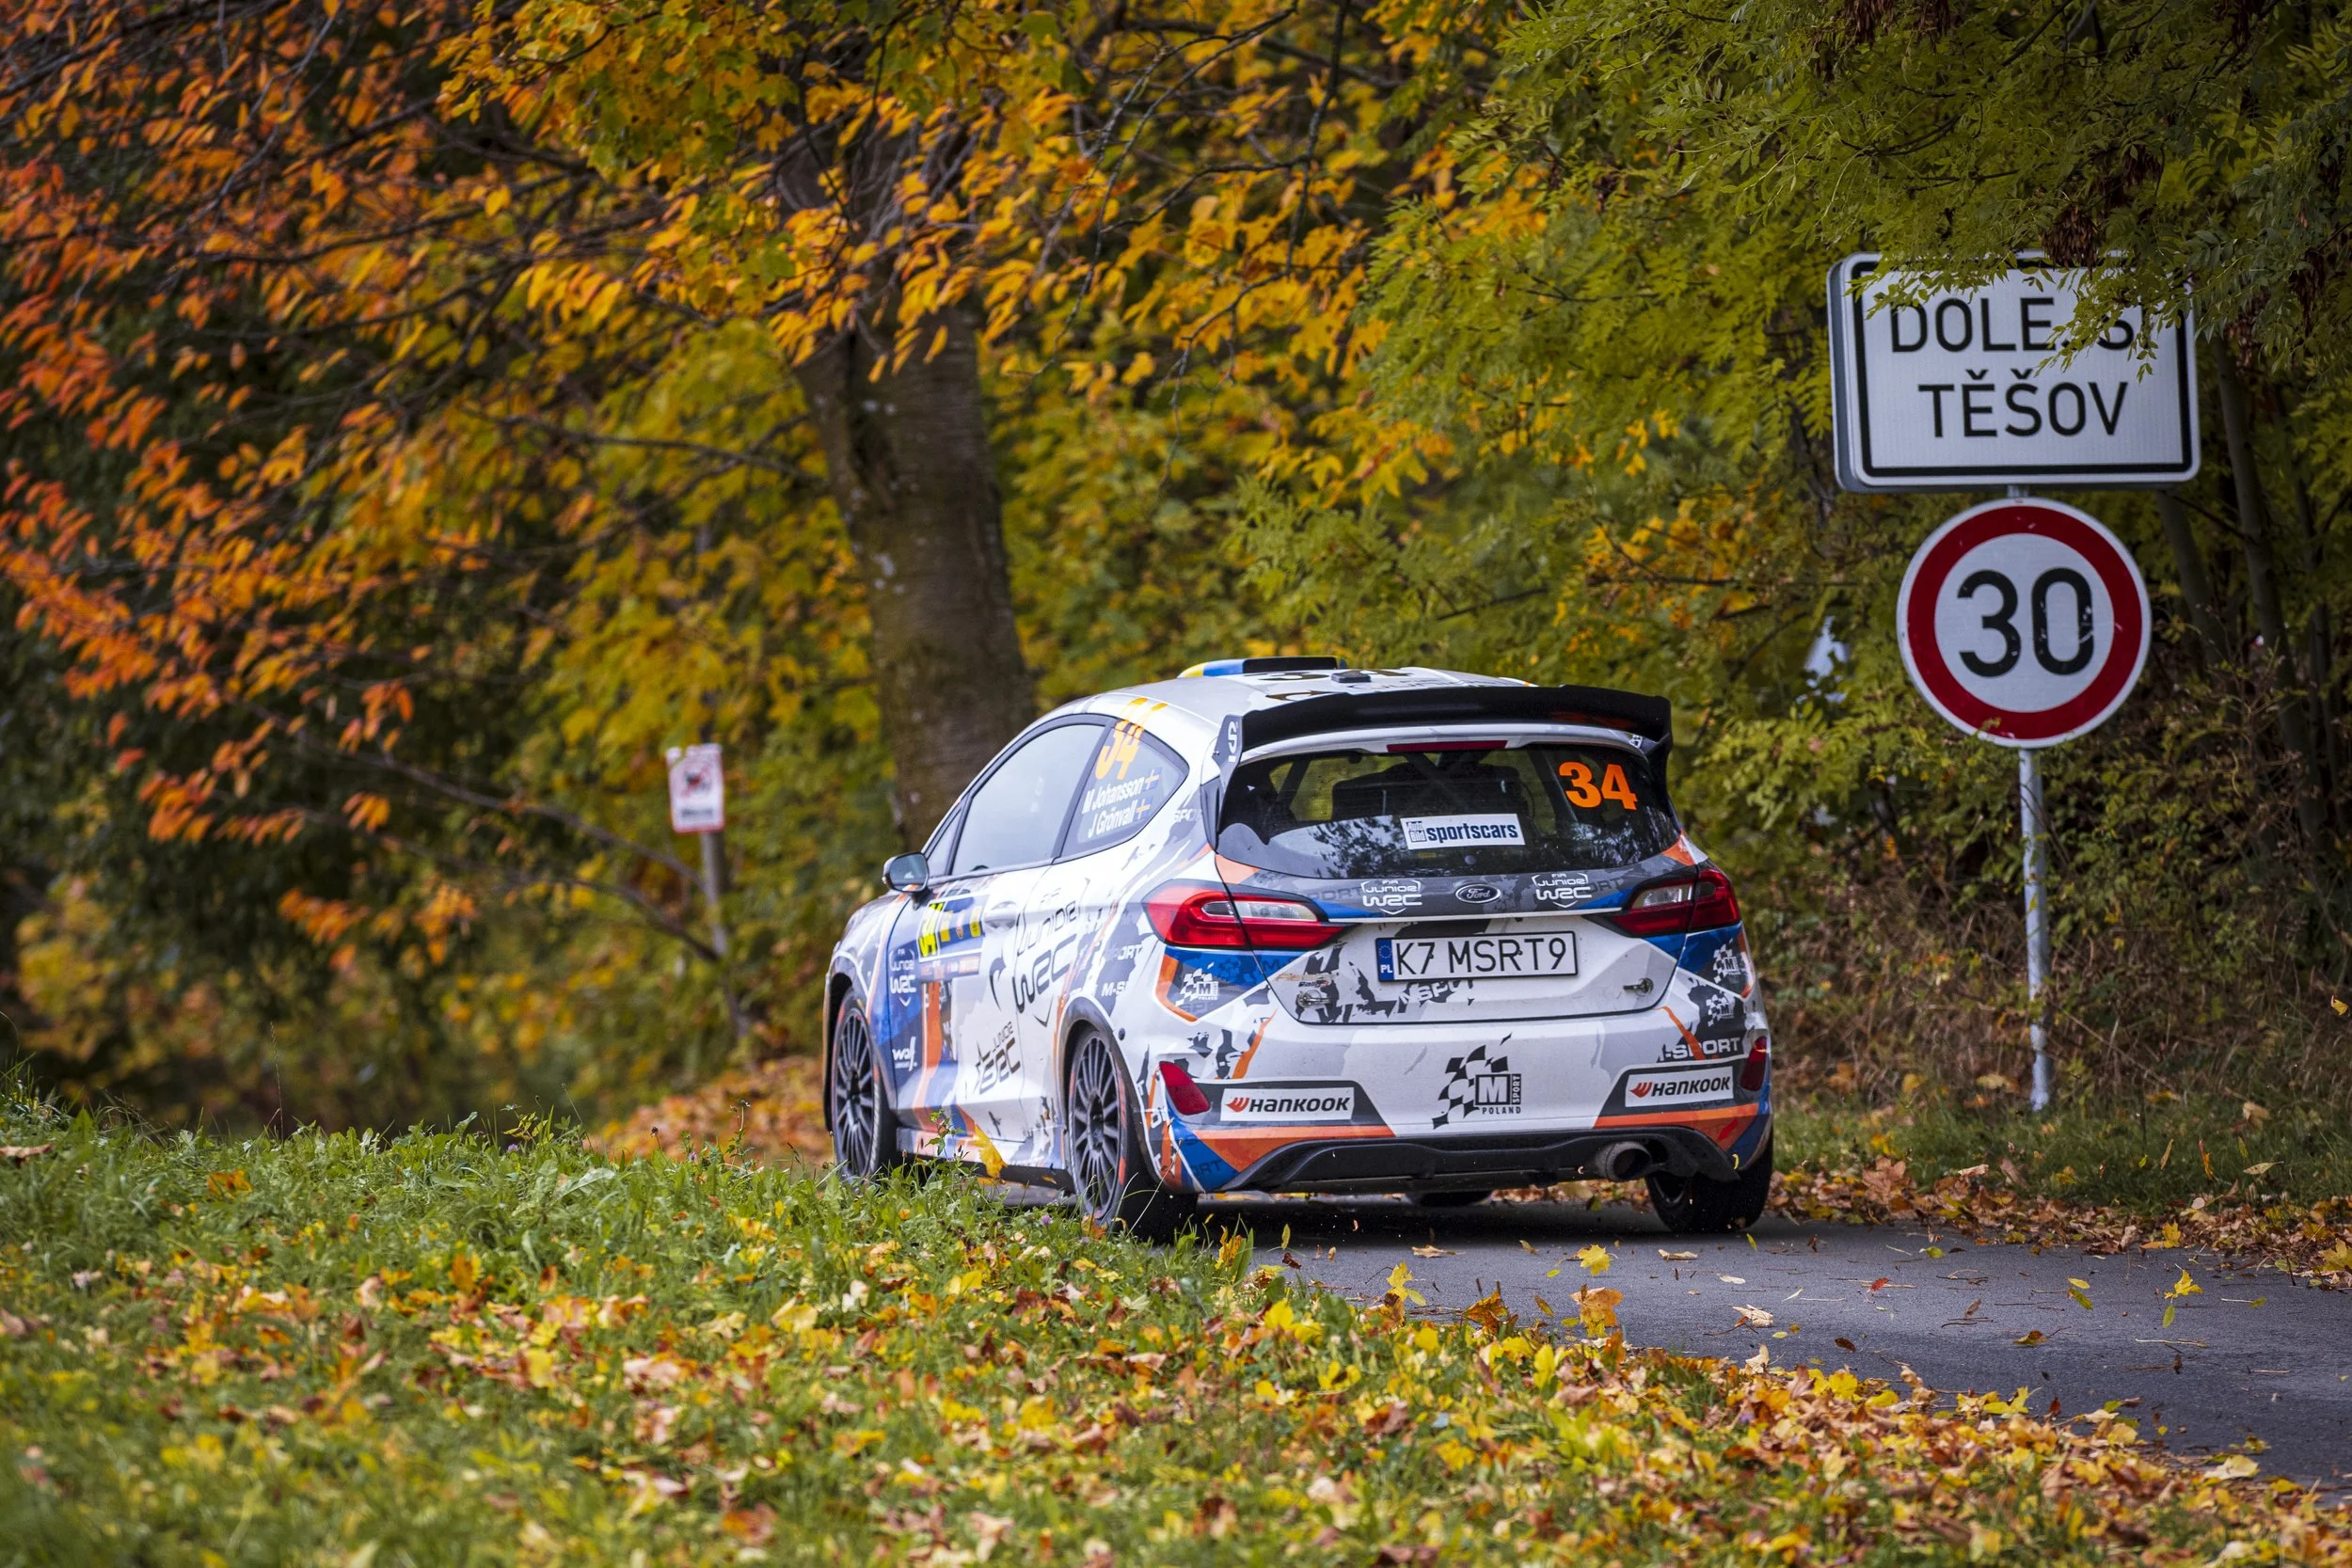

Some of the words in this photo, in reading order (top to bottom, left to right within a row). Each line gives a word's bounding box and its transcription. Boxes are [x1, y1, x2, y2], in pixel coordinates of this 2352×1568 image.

[1890, 296, 2151, 353] DOLE
[1917, 368, 2129, 438] TĚŠOV
[1957, 566, 2094, 677] 30
[1093, 777, 1145, 809] Johansson
[1559, 761, 1638, 811] 34
[1088, 813, 1097, 838] J
[1426, 823, 1518, 843] sportscars
[1362, 894, 1423, 907] WRC
[1466, 888, 1491, 899] Ford
[1535, 887, 1593, 900] WRC
[1380, 963, 1393, 974] PL
[1396, 942, 1436, 975] K7
[1448, 937, 1566, 974] MSRT9
[1478, 1076, 1507, 1103] M
[1512, 1075, 1520, 1103] SPORT
[1482, 1106, 1521, 1115] POLAND
